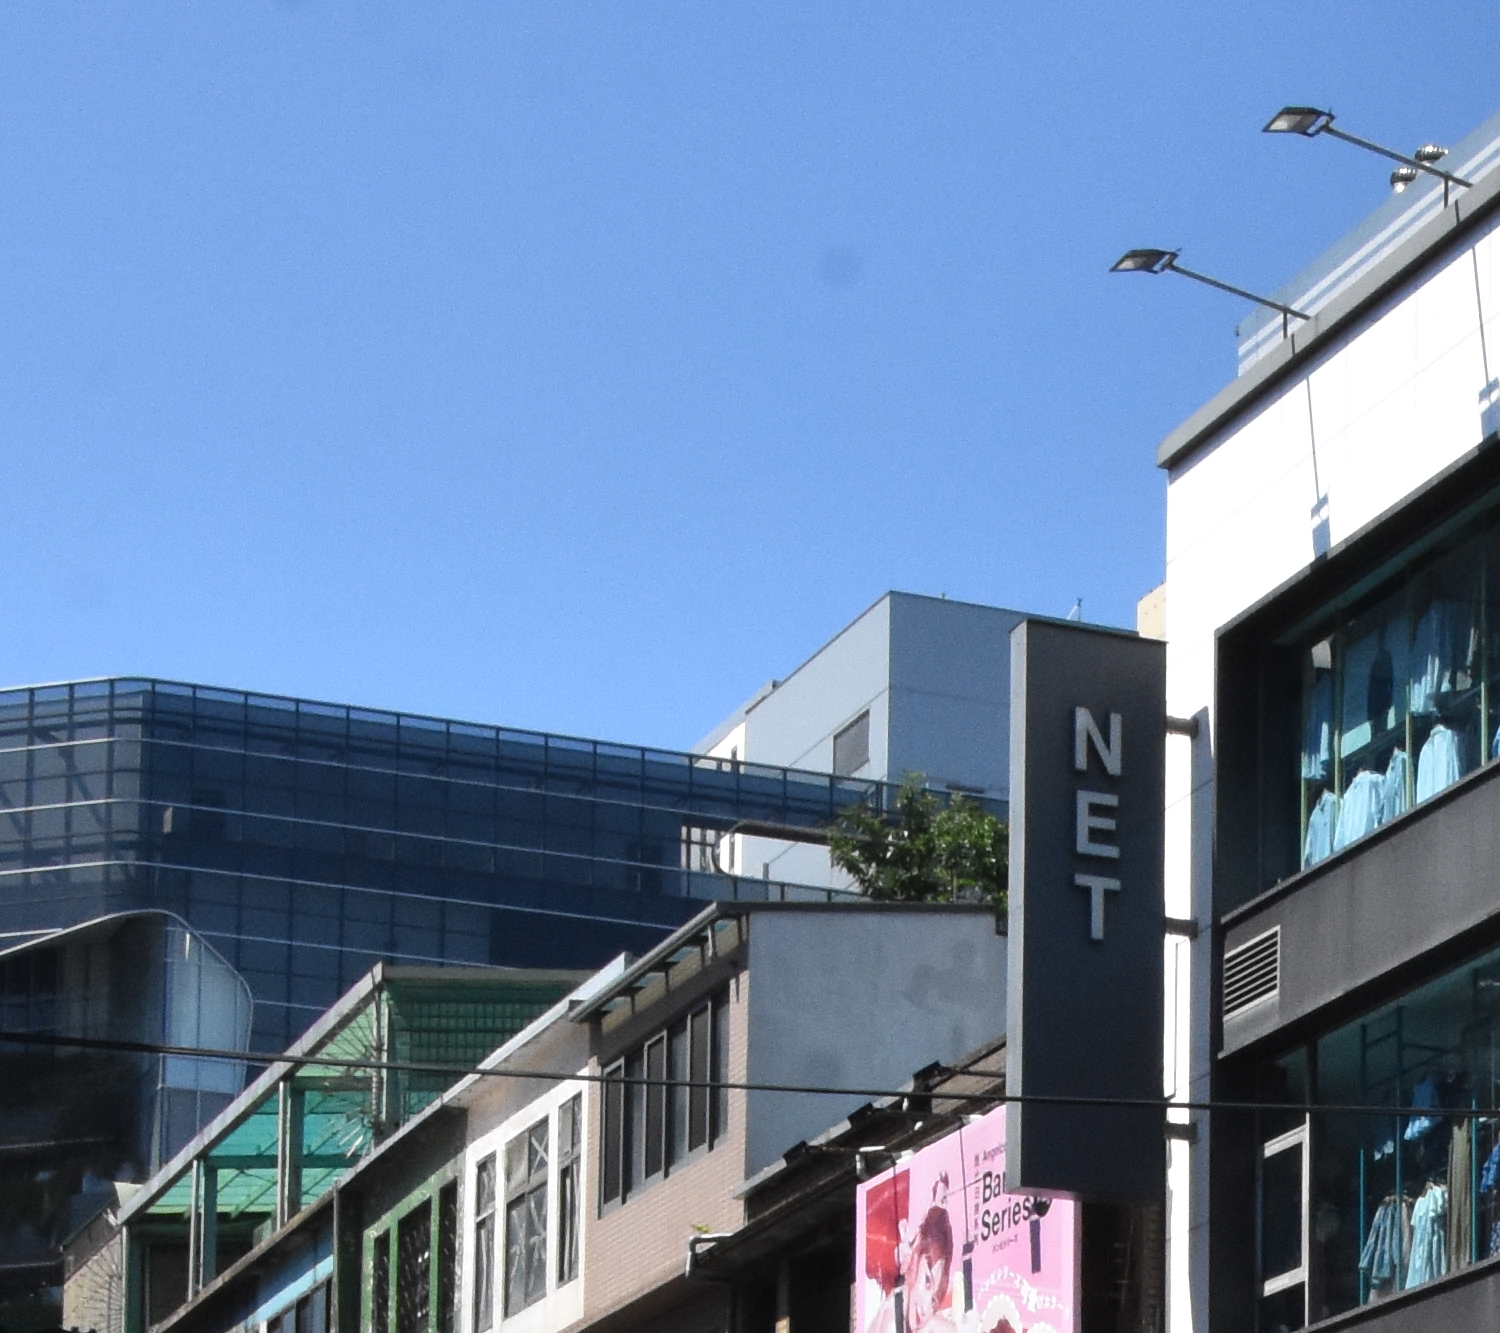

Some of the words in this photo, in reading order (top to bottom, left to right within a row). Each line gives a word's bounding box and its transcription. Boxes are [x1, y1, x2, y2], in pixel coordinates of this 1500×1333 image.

[1073, 705, 1123, 942] NET
[982, 1168, 1006, 1204] Ba
[980, 1197, 1034, 1242] Series
